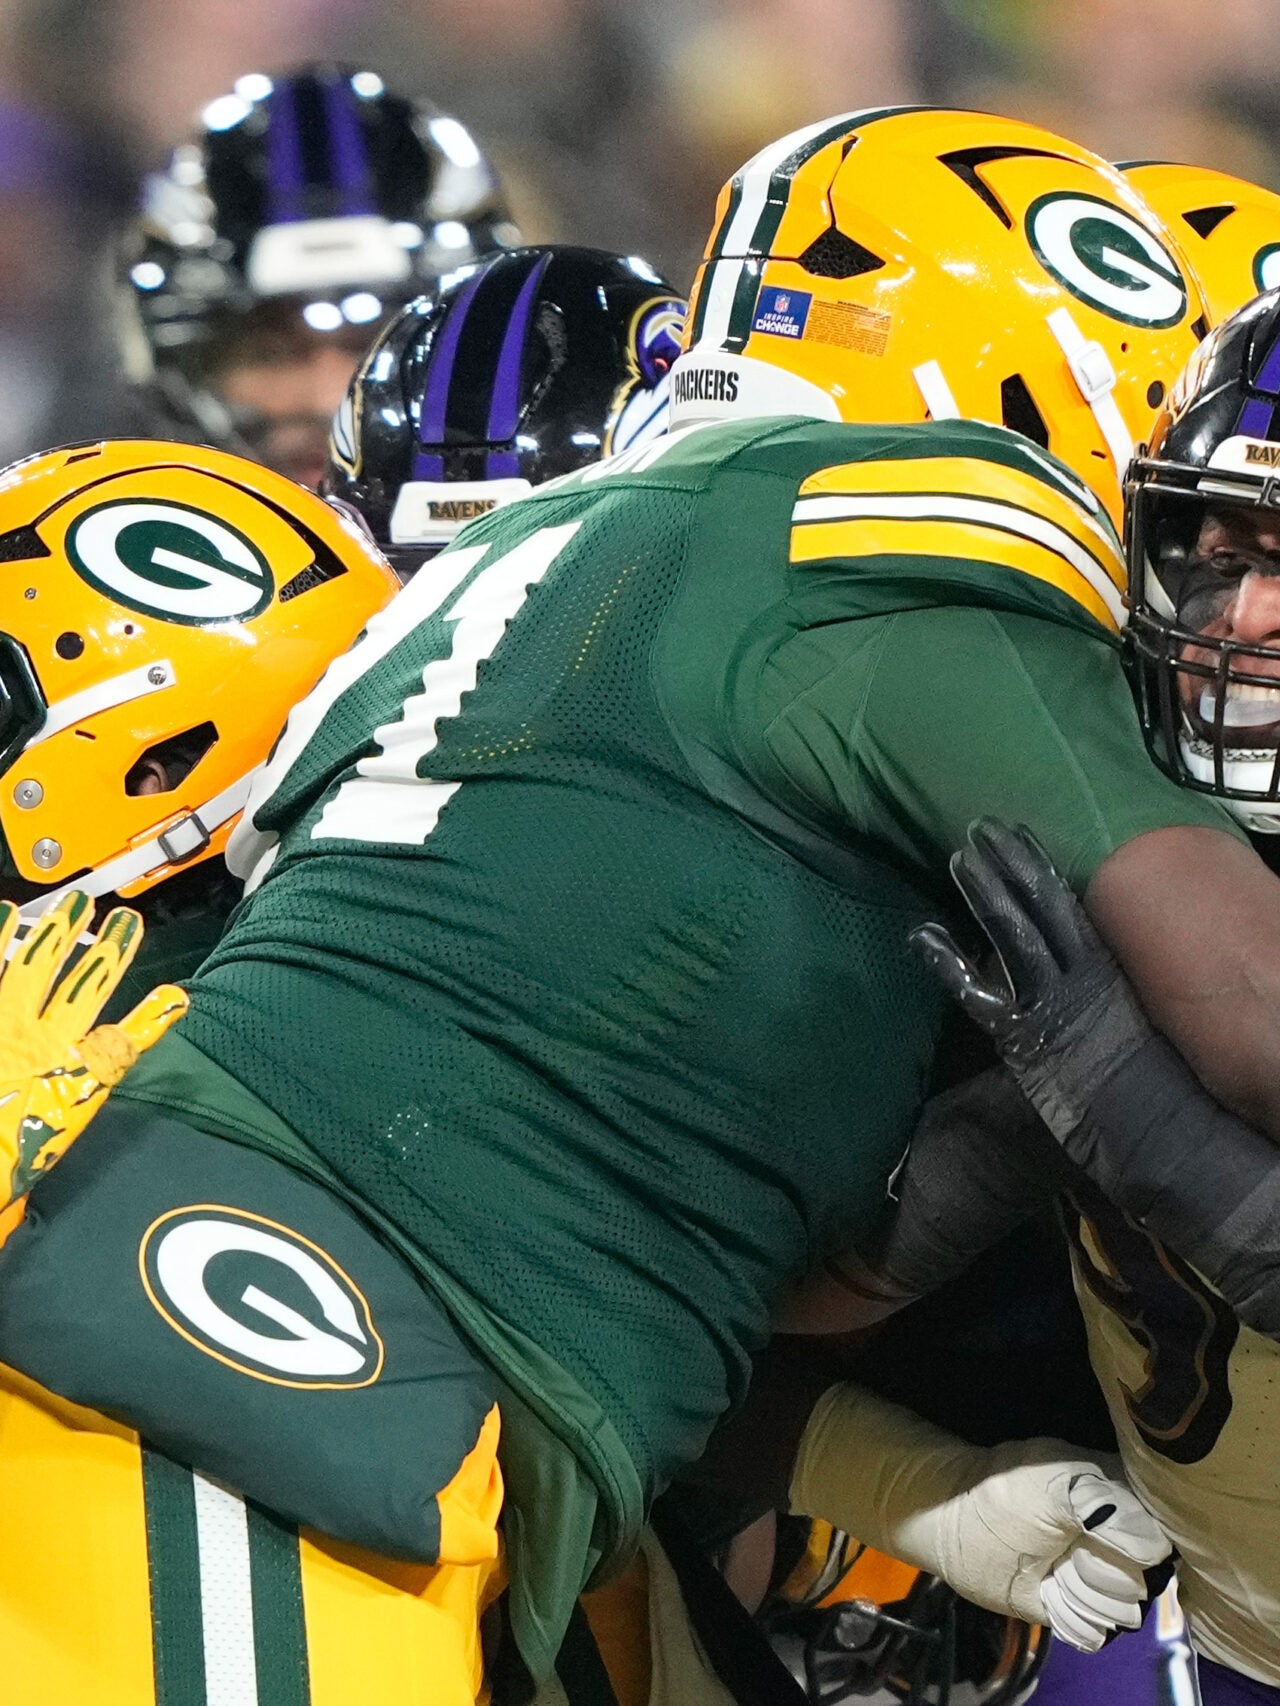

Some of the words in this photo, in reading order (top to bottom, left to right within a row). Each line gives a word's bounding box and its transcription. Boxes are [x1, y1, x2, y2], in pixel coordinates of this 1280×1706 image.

[1034, 198, 1184, 322] G
[755, 319, 800, 336] CHANGE
[764, 313, 795, 324] INSPIRE
[674, 368, 740, 405] PACKERS
[75, 504, 265, 618] G
[156, 1219, 368, 1376] G
